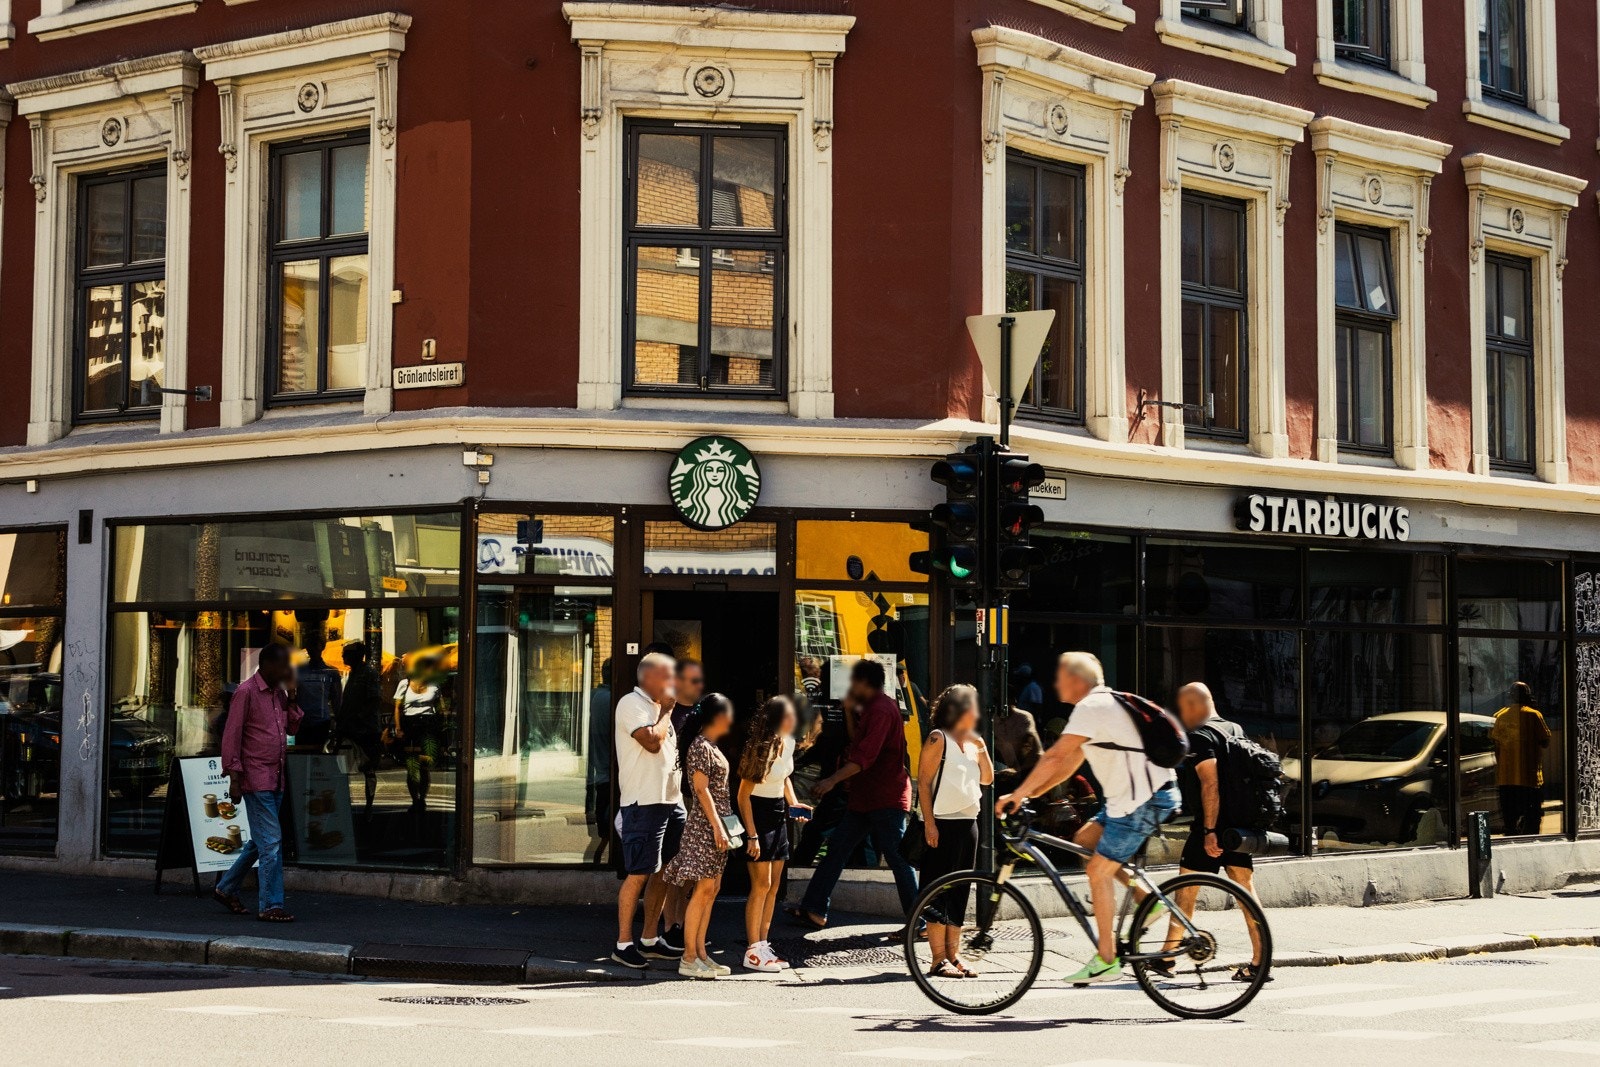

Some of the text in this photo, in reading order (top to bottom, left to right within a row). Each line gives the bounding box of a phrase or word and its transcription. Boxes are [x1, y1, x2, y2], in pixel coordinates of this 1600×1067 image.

[424, 340, 432, 358] 1
[398, 366, 458, 384] Grönlandsleiret
[1249, 493, 1410, 541] STARBUCKS
